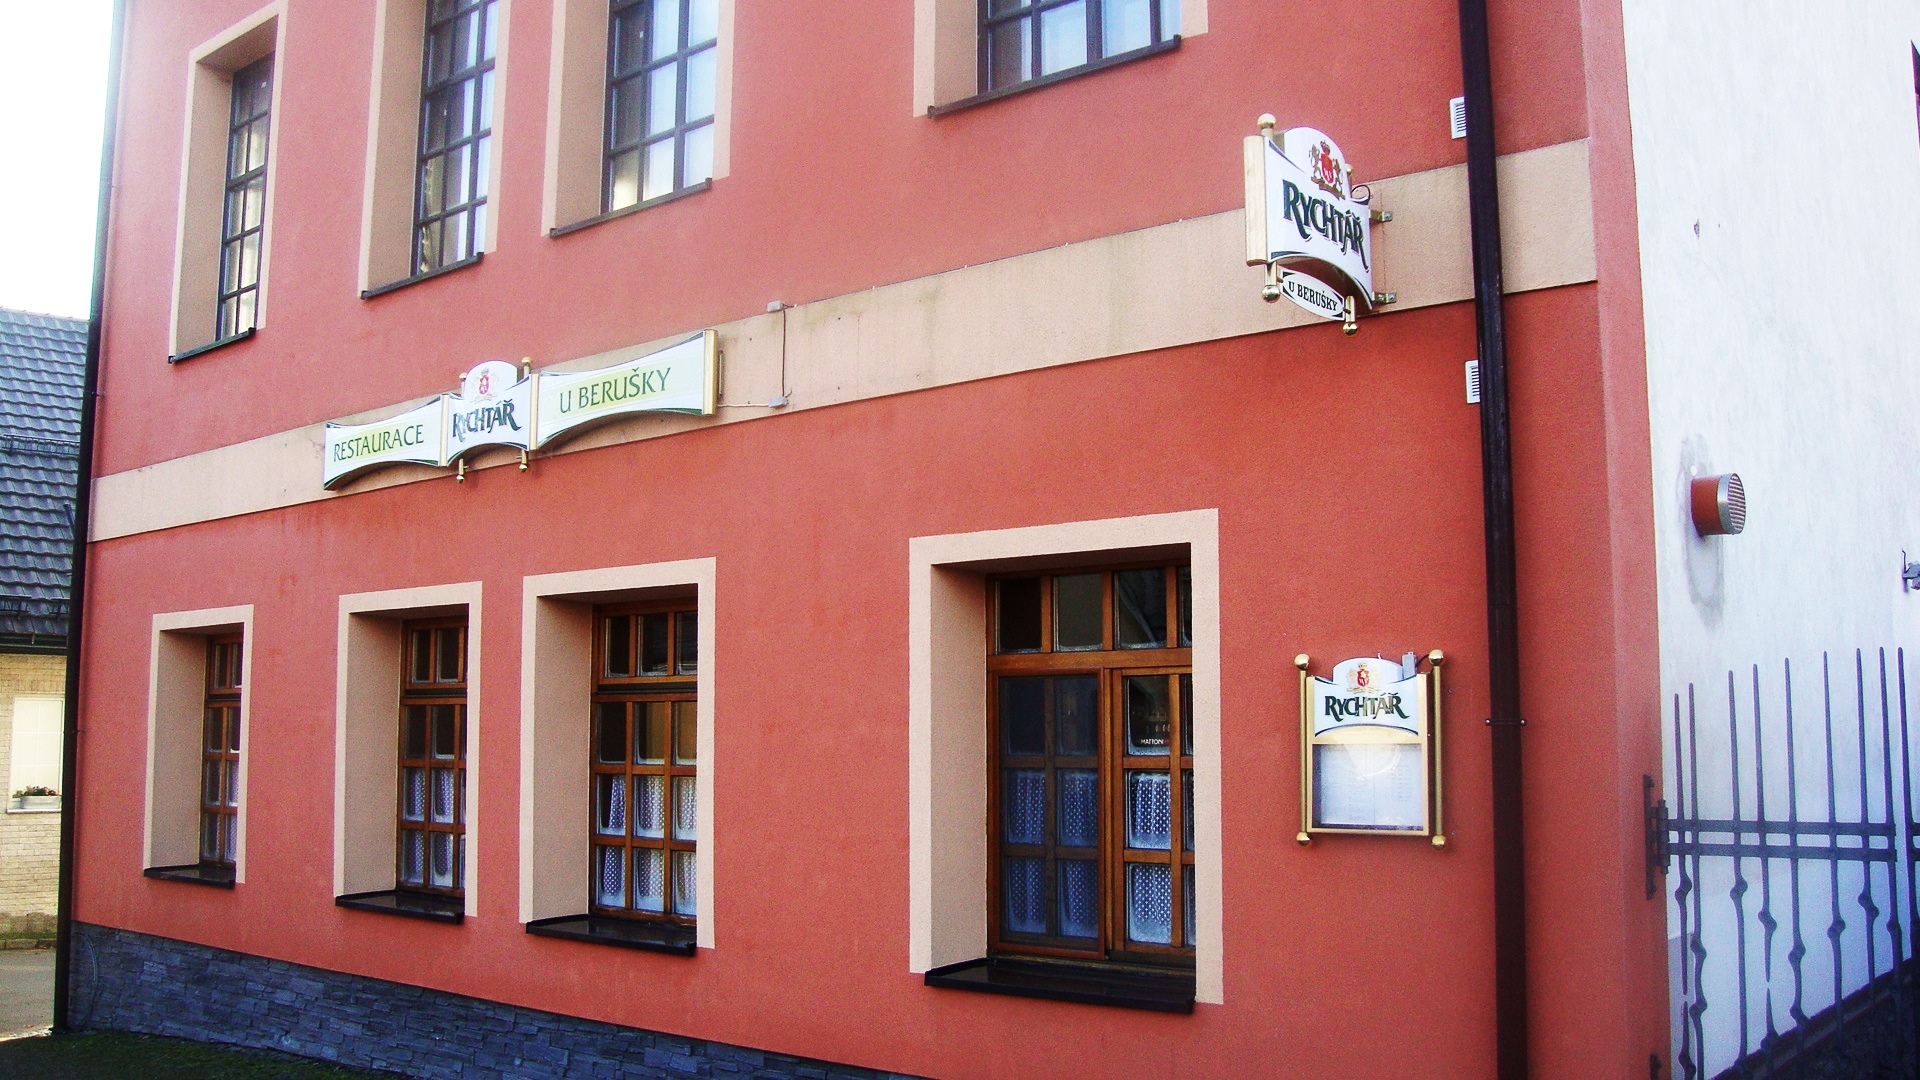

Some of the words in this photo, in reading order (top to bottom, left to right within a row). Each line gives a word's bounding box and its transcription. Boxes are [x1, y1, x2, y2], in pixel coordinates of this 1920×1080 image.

[1282, 179, 1370, 273] RYCHTÁŘ
[1288, 281, 1295, 293] U
[560, 390, 572, 414] U
[578, 367, 672, 409] BERUŠKY
[452, 398, 523, 443] RYCHTÁŘ
[333, 424, 425, 462] RESTAURACE
[1324, 692, 1411, 722] RYCHTÁŘ
